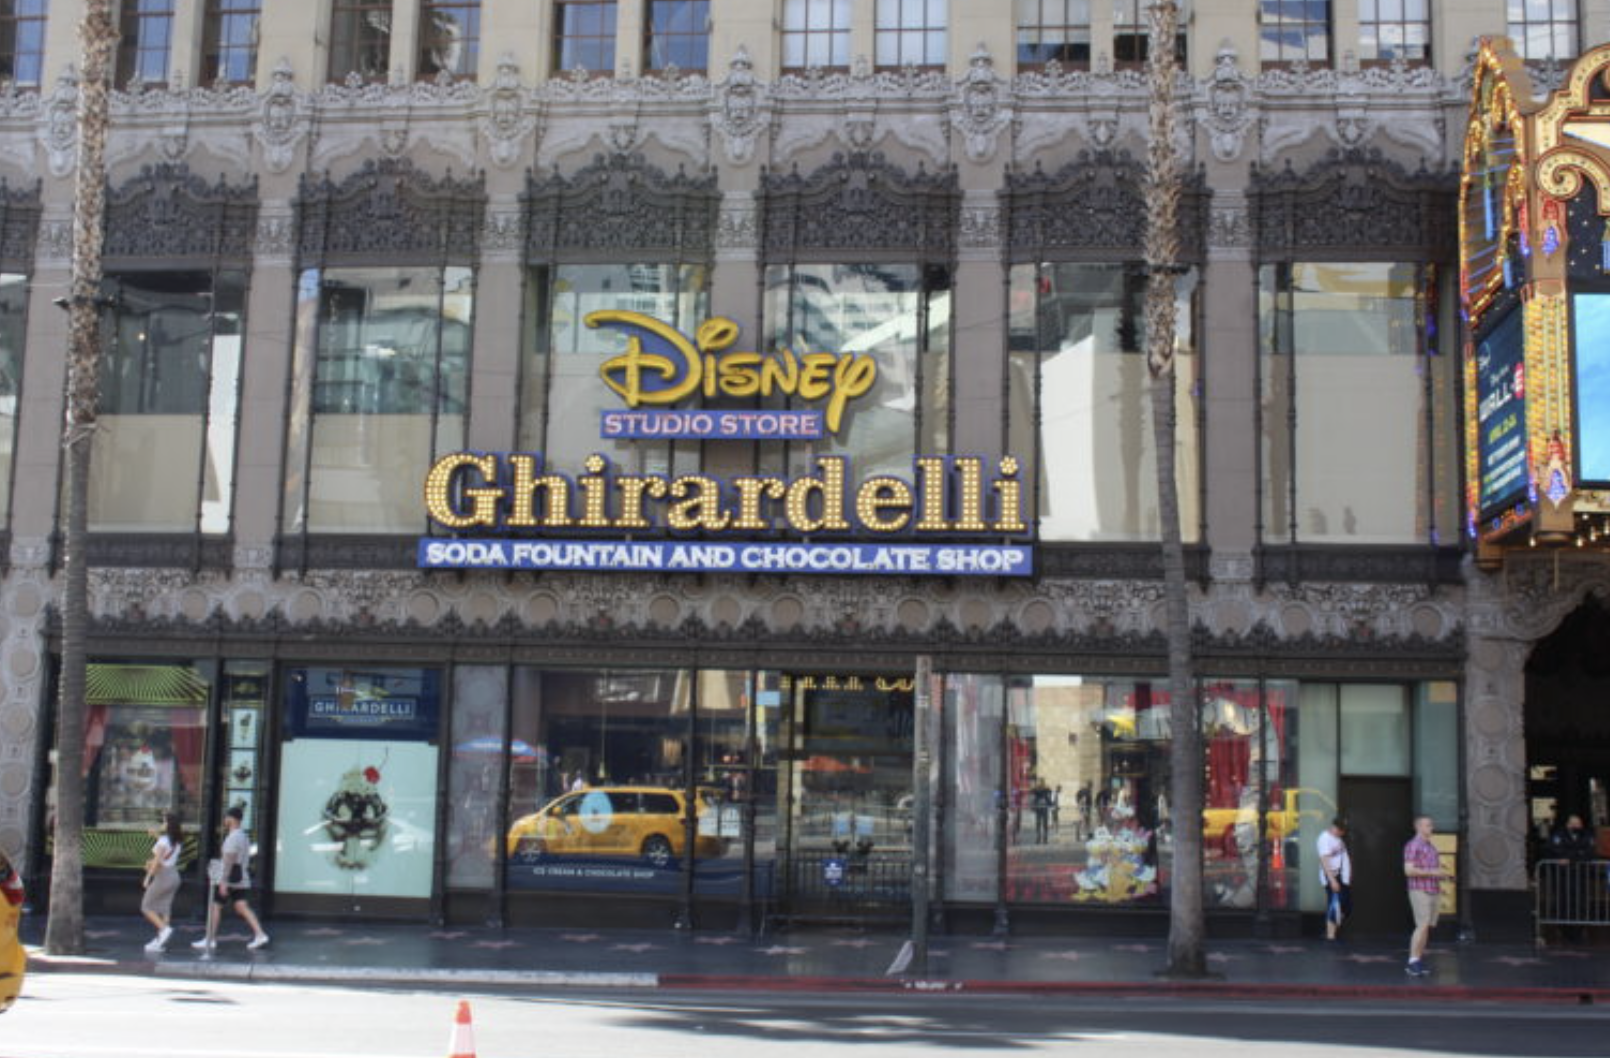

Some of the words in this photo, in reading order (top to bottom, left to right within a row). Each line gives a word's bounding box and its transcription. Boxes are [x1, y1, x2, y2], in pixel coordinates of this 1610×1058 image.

[583, 309, 876, 433] Disney
[604, 414, 713, 434] STUDIO
[719, 414, 820, 435] STORE
[424, 453, 1025, 532] Ghirardelli
[426, 543, 508, 565] SODA
[513, 544, 662, 567] FOUNTAIN
[668, 545, 736, 568] AND
[740, 546, 931, 570] CHOCOLATE
[936, 549, 1024, 571] SHOP
[314, 701, 411, 714] GHIARDELLI
[584, 869, 631, 878] CHOCOLATE
